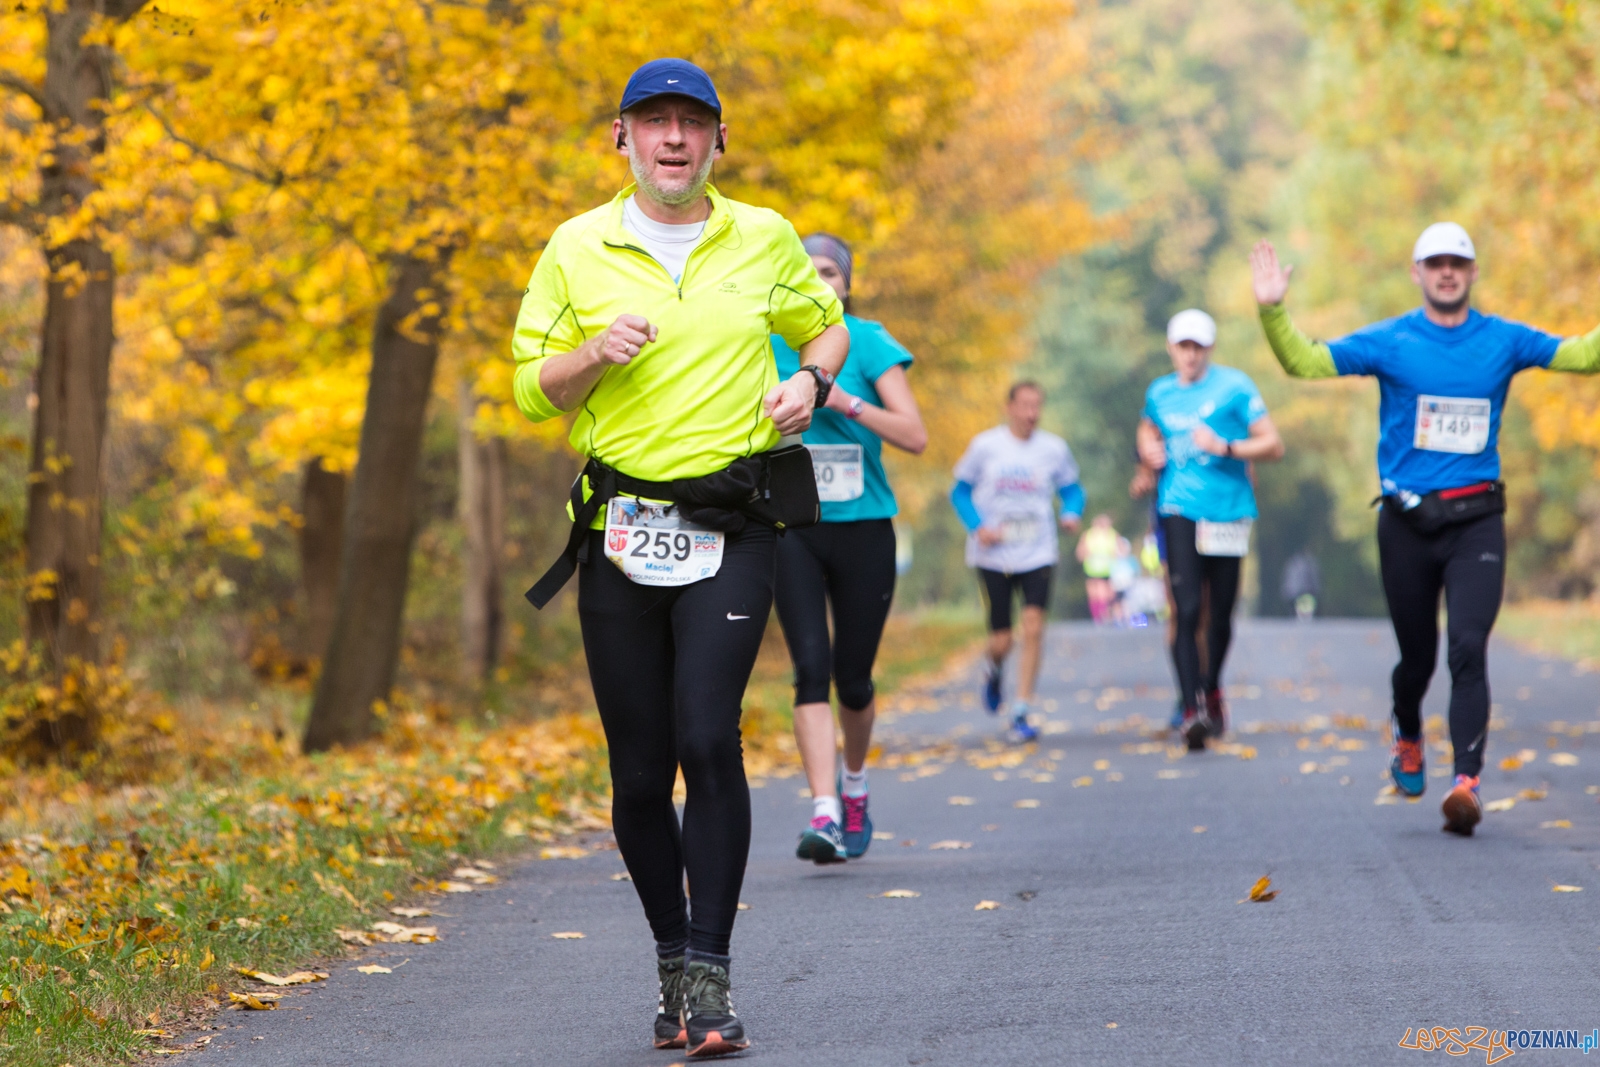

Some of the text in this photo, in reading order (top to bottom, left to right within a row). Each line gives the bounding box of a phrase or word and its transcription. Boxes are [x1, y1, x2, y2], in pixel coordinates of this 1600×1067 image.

[1436, 415, 1471, 436] 149
[630, 529, 692, 562] 259
[645, 563, 674, 574] Maciej
